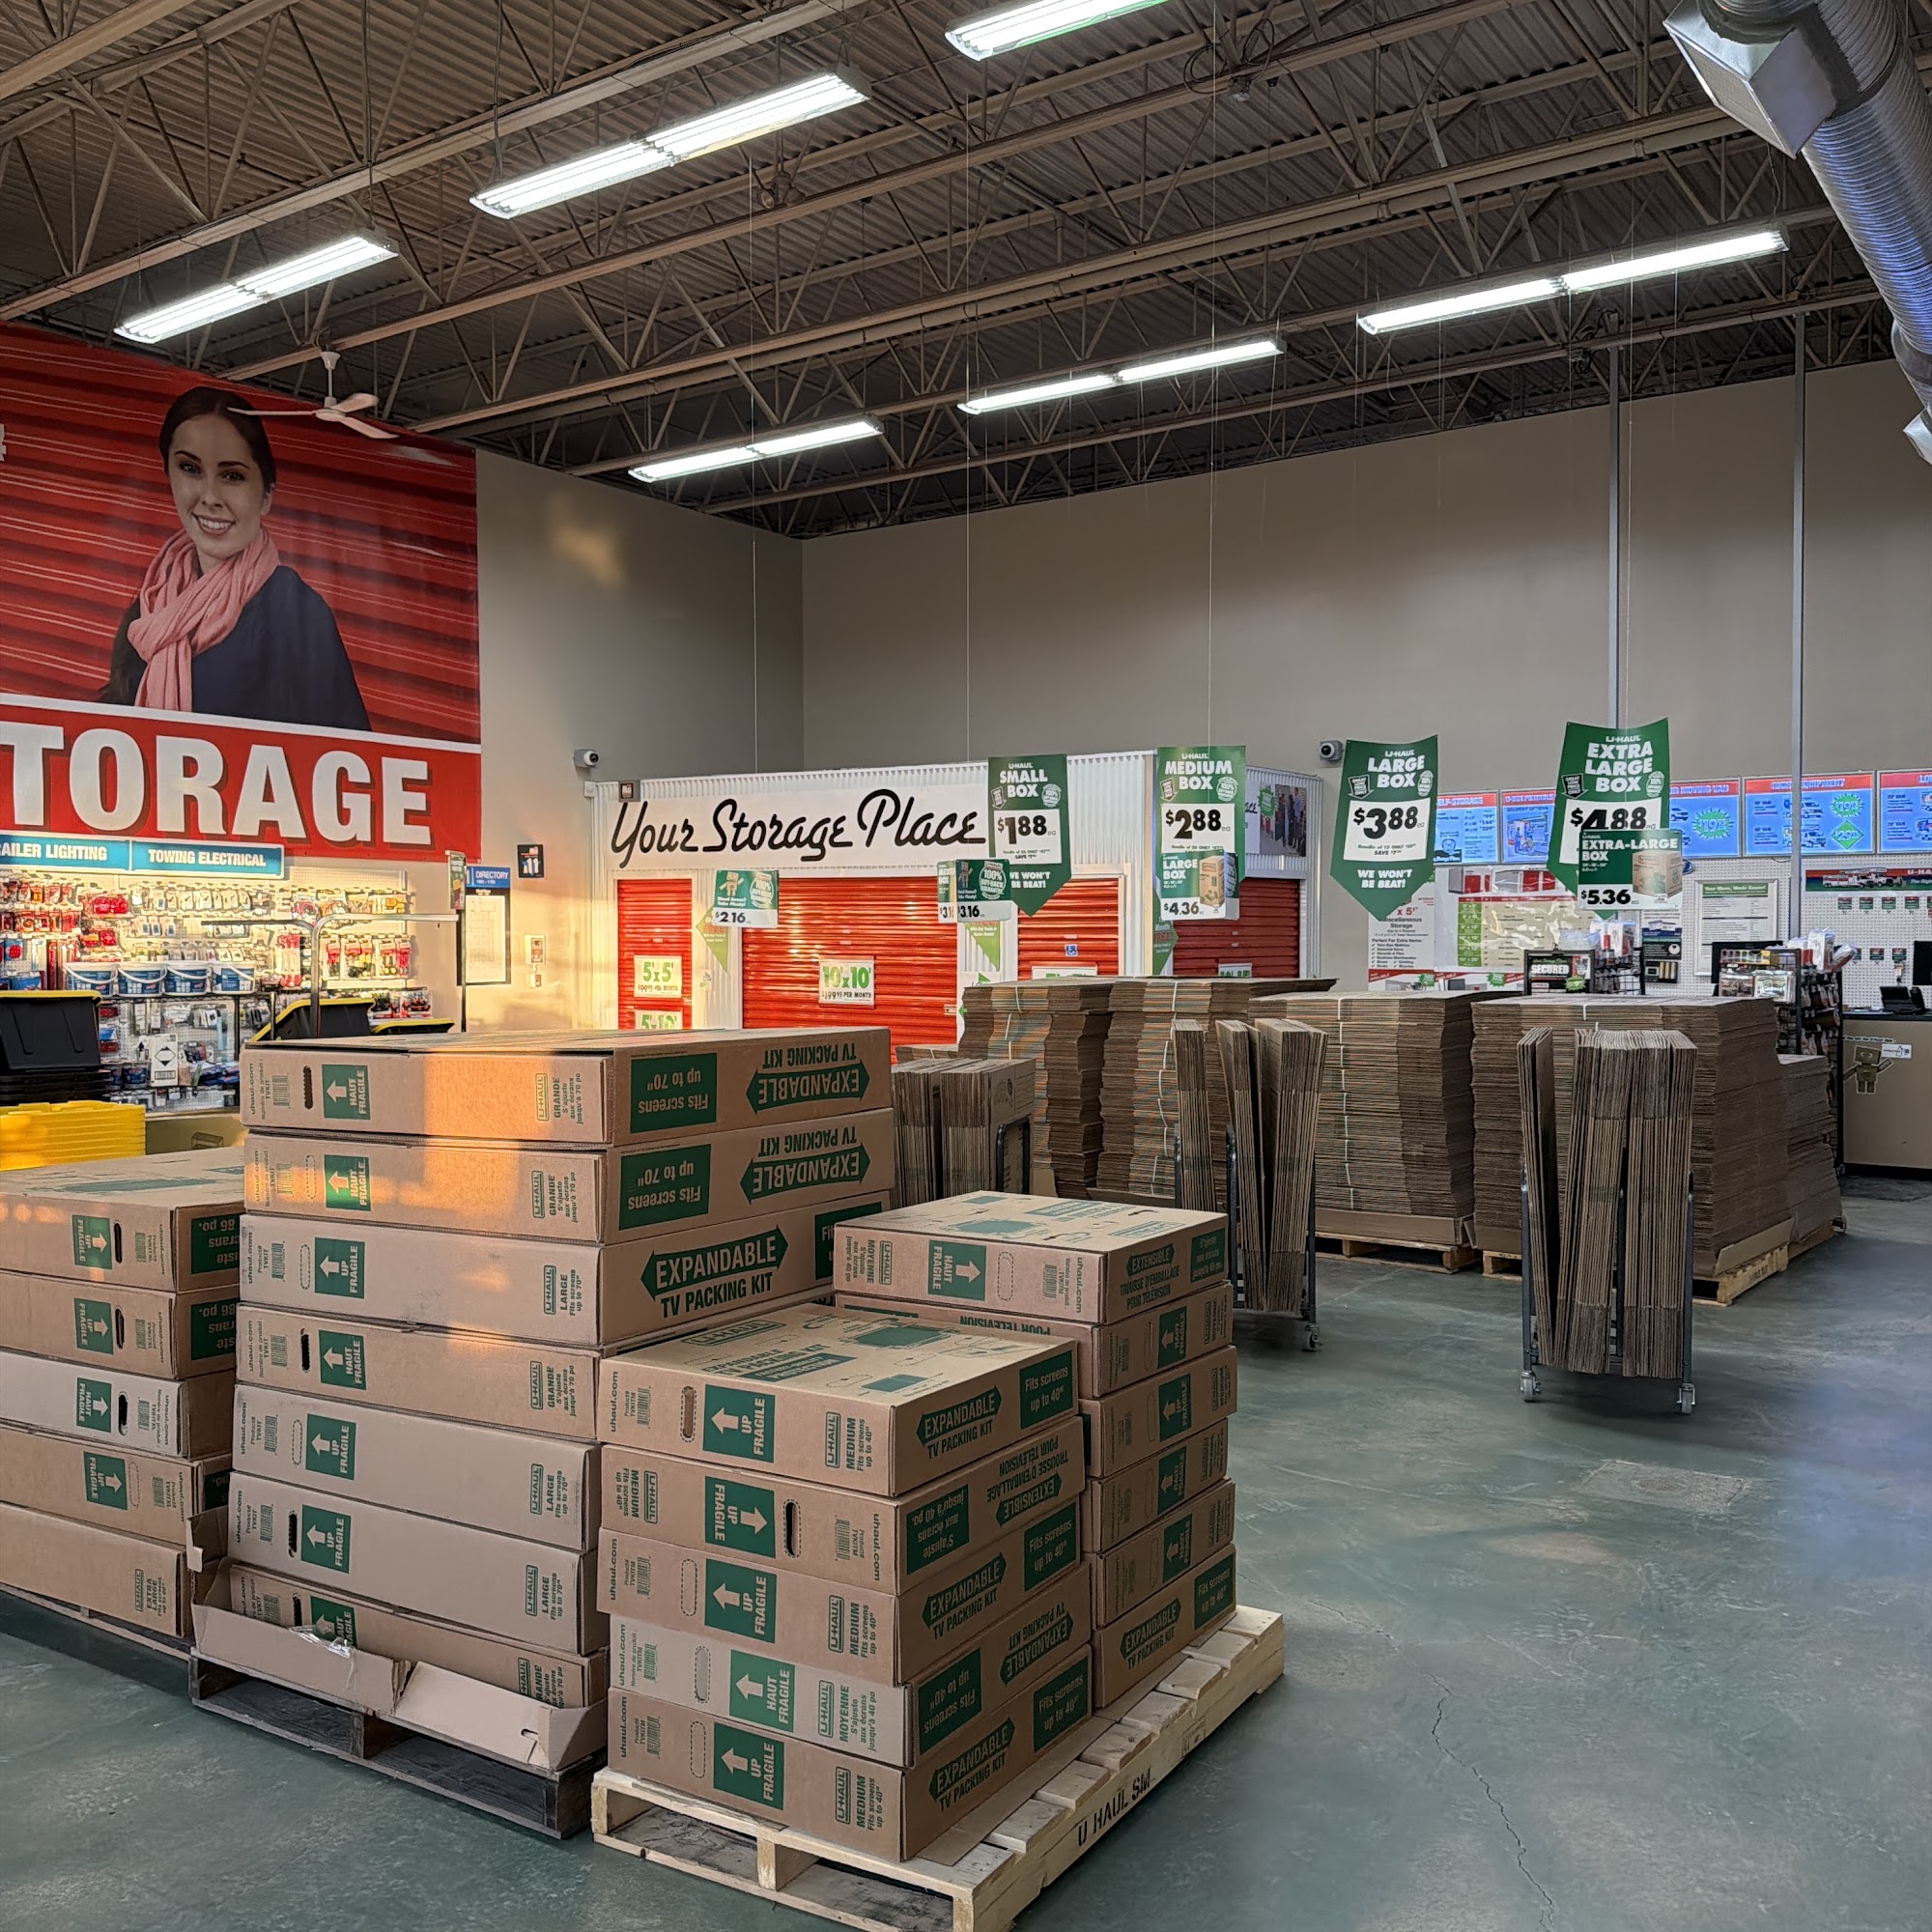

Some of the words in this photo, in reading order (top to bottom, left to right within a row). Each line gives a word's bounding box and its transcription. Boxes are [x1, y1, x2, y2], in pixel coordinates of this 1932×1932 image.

[1587, 741, 1653, 759] EXTRA
[1000, 769, 1048, 783] SMALL
[1165, 760, 1233, 775] MEDIUM
[1368, 755, 1425, 773] LARGE
[1585, 757, 1653, 776] LARGE
[0, 721, 432, 844] TORAGE
[1008, 784, 1038, 798] BOX
[1179, 776, 1213, 790] BOX
[1377, 773, 1416, 788] BOX
[1595, 777, 1642, 792] BOX
[1436, 797, 1483, 806] ELF-STORAGE
[611, 802, 698, 868] Your
[703, 799, 853, 862] Storage
[858, 789, 985, 847] Place
[0, 842, 42, 858] AILER
[46, 844, 107, 861] LIGHTING
[1582, 838, 1678, 850] EXTRA-LARGE
[1582, 851, 1608, 862] BOX
[149, 849, 195, 864] TOWING
[198, 850, 266, 867] ELECTRICAL
[1163, 859, 1198, 869] LARGE
[984, 869, 1002, 880] 100%
[1163, 869, 1186, 879] BOX
[1357, 869, 1374, 878] WE
[1378, 869, 1412, 878] WON'T
[1378, 879, 1406, 888] BEAT!
[1164, 901, 1199, 916] $4.36
[1581, 890, 1631, 904] $5.36
[1531, 965, 1570, 974] SECURED
[763, 1049, 783, 1069] KIT
[786, 1045, 838, 1066] PACKING
[840, 1043, 856, 1062] TV
[357, 1070, 366, 1114] FRAGILE
[757, 1068, 860, 1105] EXPANDABLE
[638, 1097, 685, 1114] screens
[688, 1094, 709, 1111] Fits
[758, 1136, 781, 1157] KIT
[784, 1130, 838, 1153] PACKING
[840, 1126, 857, 1145] TV
[349, 1169, 357, 1197] HAUT
[357, 1161, 367, 1206] FRAGILE
[753, 1151, 860, 1194] EXPANDABLE
[628, 1190, 676, 1209] screens
[678, 1185, 700, 1204] Fits
[77, 1219, 86, 1263] FRAGILE
[341, 1261, 349, 1276] UP
[350, 1245, 358, 1293] FRAGILE
[655, 1235, 777, 1290] EXPANDABLE
[867, 1239, 875, 1284] MOYENNE
[932, 1246, 943, 1291] FRAGILE
[943, 1255, 953, 1284] HAUT
[1130, 1247, 1171, 1273] EXTENSIBLE
[661, 1289, 680, 1318] TV
[685, 1279, 747, 1314] PACKING
[752, 1271, 773, 1294] KIT
[1075, 1257, 1084, 1314] uhaul.com
[79, 1303, 88, 1346] FRAGILE
[345, 1347, 354, 1375] HAUT
[353, 1340, 362, 1384] FRAGILE
[1025, 1378, 1039, 1393] Fits
[1040, 1366, 1069, 1386] screens
[610, 1371, 618, 1433] uhaul.com
[923, 1392, 995, 1439] EXPANDABLE
[742, 1414, 753, 1435] UP
[753, 1397, 766, 1457] FRAGILE
[331, 1440, 339, 1456] UP
[339, 1425, 350, 1474] FRAGILE
[846, 1417, 857, 1470] MEDIUM
[926, 1442, 940, 1460] TV
[941, 1425, 979, 1452] PACKING
[980, 1419, 993, 1436] KIT
[90, 1457, 99, 1499] FRAGILE
[631, 1468, 639, 1519] MEDIUM
[1003, 1478, 1056, 1520] EXTENSIBLE
[714, 1483, 725, 1542] FRAGILE
[726, 1505, 738, 1525] UP
[327, 1531, 335, 1548] UP
[334, 1518, 345, 1567] FRAGILE
[609, 1538, 617, 1601] uhaul.com
[742, 1591, 753, 1612] UP
[929, 1562, 1001, 1620] EXPANDABLE
[754, 1576, 768, 1635] FRAGILE
[850, 1602, 860, 1656] MEDIUM
[766, 1675, 777, 1711] HAUT
[778, 1668, 791, 1724] FRAGILE
[839, 1685, 850, 1742] MOYENNE
[751, 1758, 760, 1778] UP
[763, 1742, 775, 1802] FRAGILE
[936, 1724, 1009, 1793] EXPANDABLE
[856, 1774, 866, 1828] MEDIUM
[1077, 1818, 1088, 1847] U
[1093, 1792, 1129, 1833] HAUL
[1131, 1766, 1151, 1803] SM
